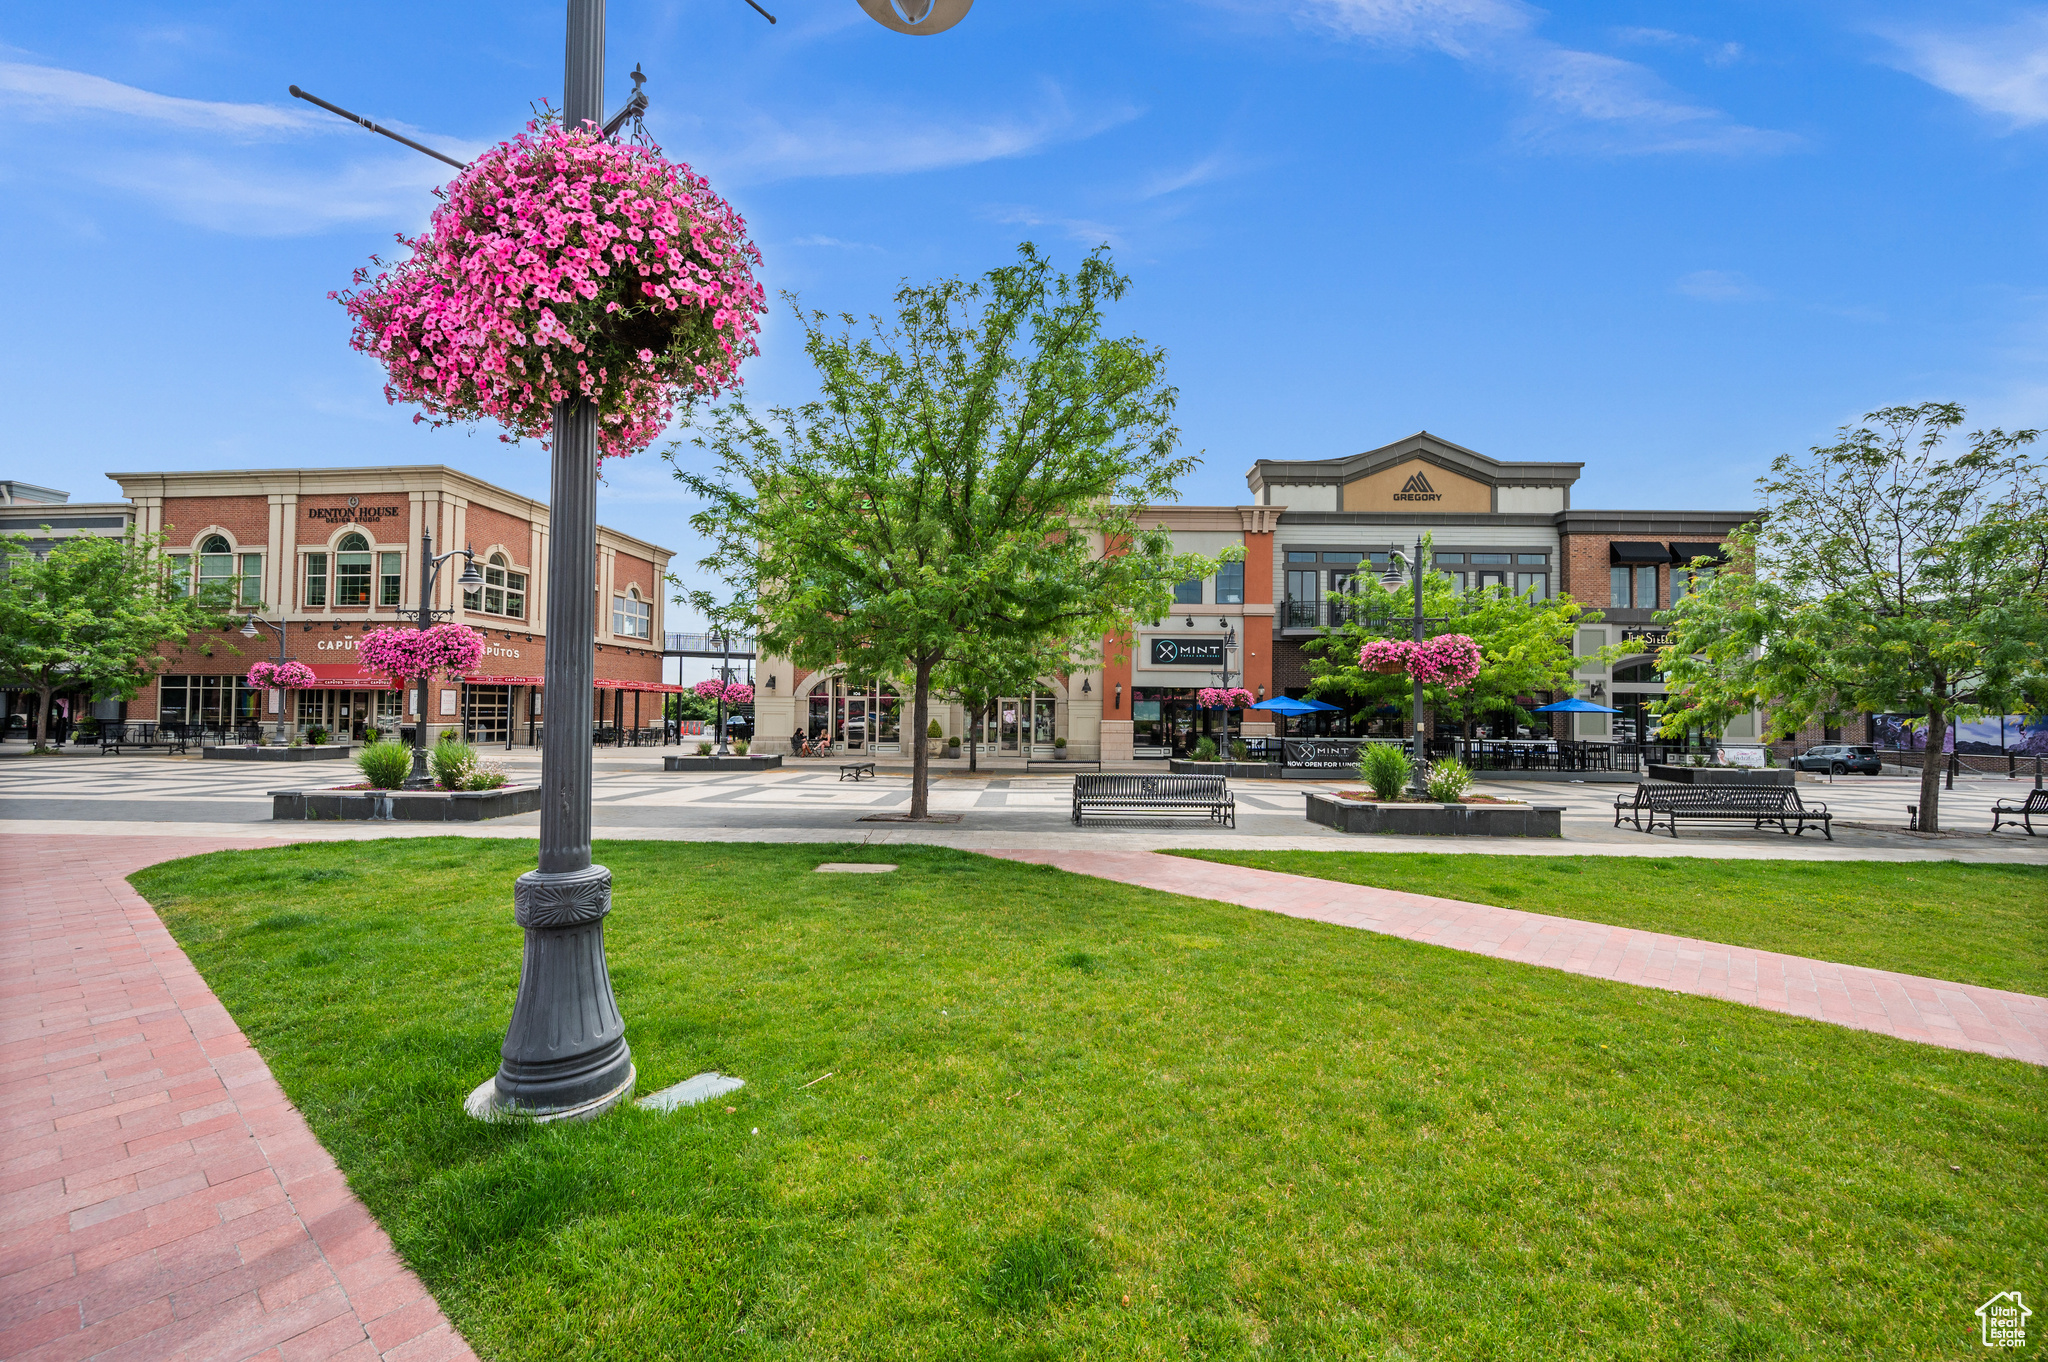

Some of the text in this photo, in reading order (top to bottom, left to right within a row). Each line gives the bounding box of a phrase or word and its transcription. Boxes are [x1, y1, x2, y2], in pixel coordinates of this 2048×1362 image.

[1393, 493, 1442, 501] GREGORY
[308, 506, 399, 518] DENTON HOUSE
[317, 640, 360, 650] CAPUT
[1180, 646, 1220, 654] MINT
[482, 646, 520, 659] PUTO'S
